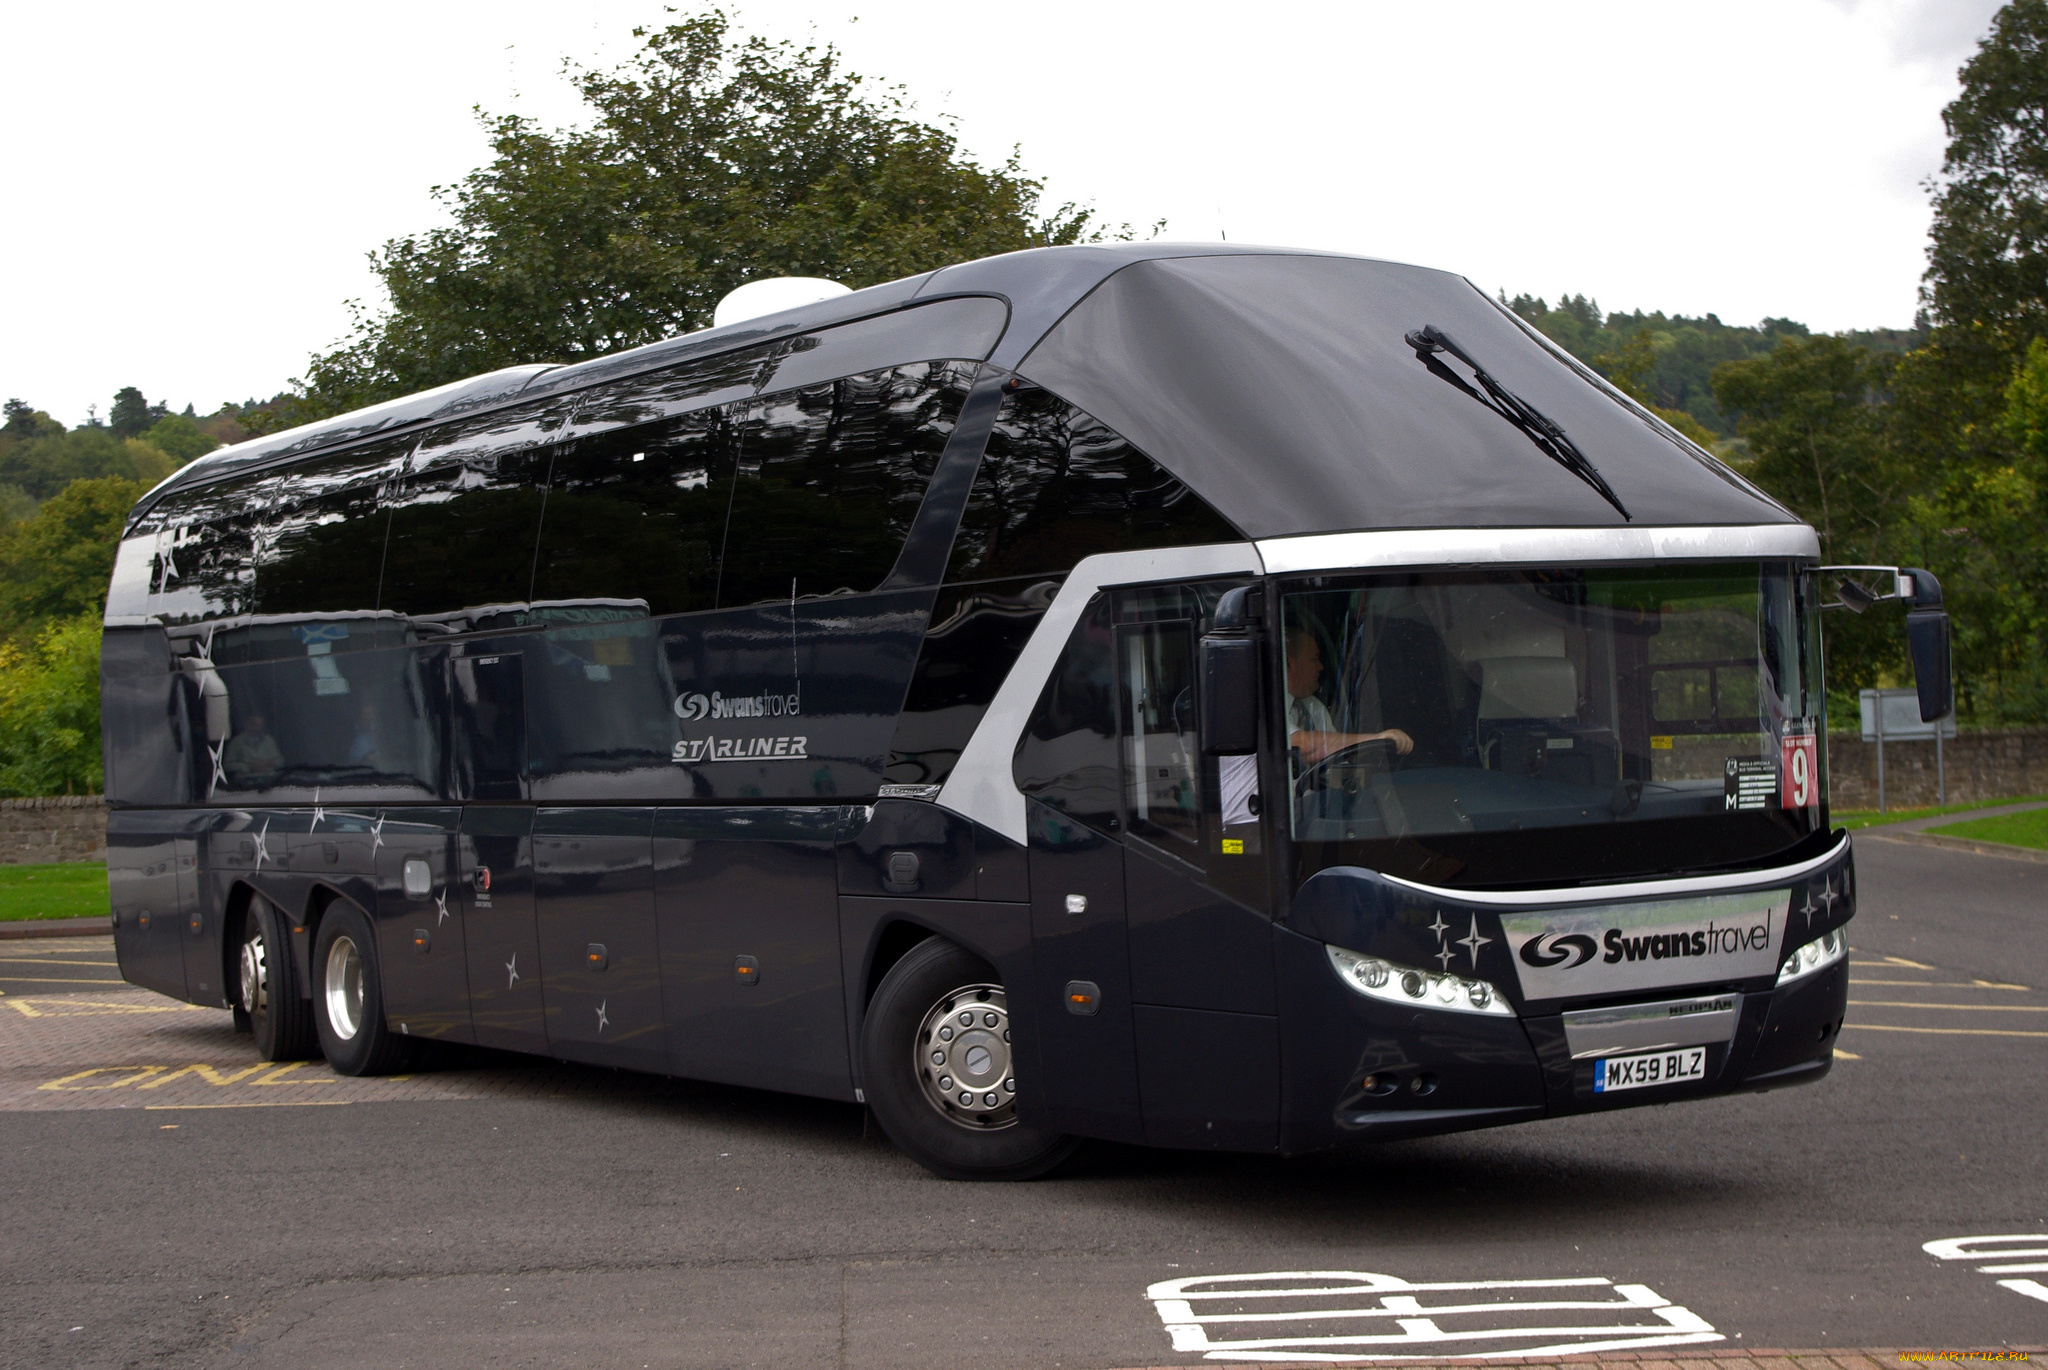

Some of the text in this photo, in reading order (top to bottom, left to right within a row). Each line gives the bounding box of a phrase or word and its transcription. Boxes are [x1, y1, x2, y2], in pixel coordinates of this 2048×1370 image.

[672, 735, 808, 762] STARLINER
[1792, 747, 1808, 808] 9
[1725, 793, 1737, 810] M
[1603, 908, 1771, 964] Swanstravel
[1669, 999, 1733, 1016] NEOPLAN
[36, 1061, 410, 1091] ONL
[1607, 1058, 1661, 1087] MX59
[1666, 1052, 1702, 1079] BLZ
